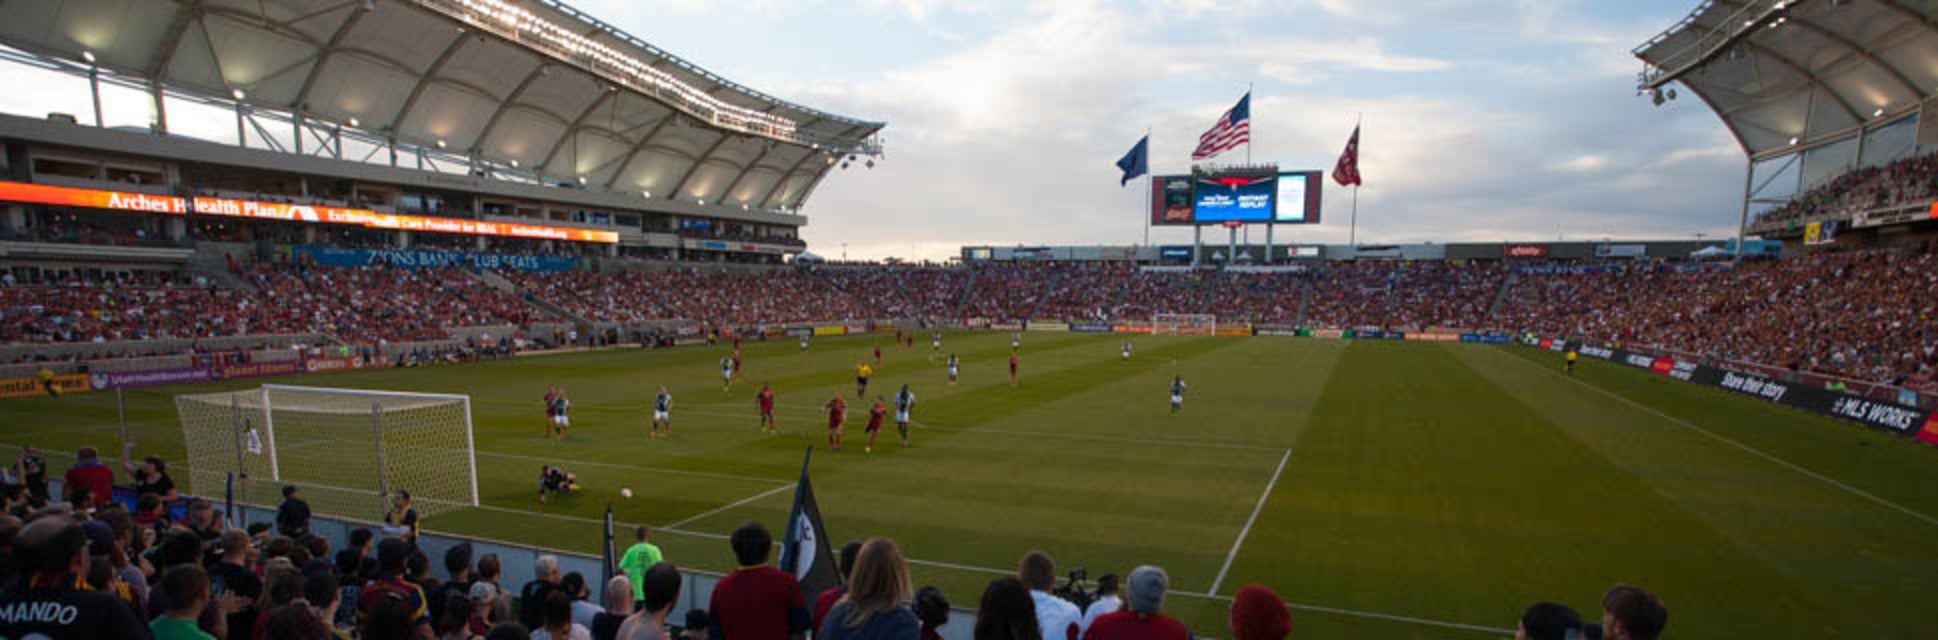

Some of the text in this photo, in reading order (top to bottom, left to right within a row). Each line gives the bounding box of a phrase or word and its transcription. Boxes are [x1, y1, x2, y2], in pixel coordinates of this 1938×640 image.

[108, 191, 169, 213] Arches
[1721, 371, 1788, 401] Share their story
[1840, 398, 1871, 419] MLS
[1867, 403, 1916, 430] WORKS
